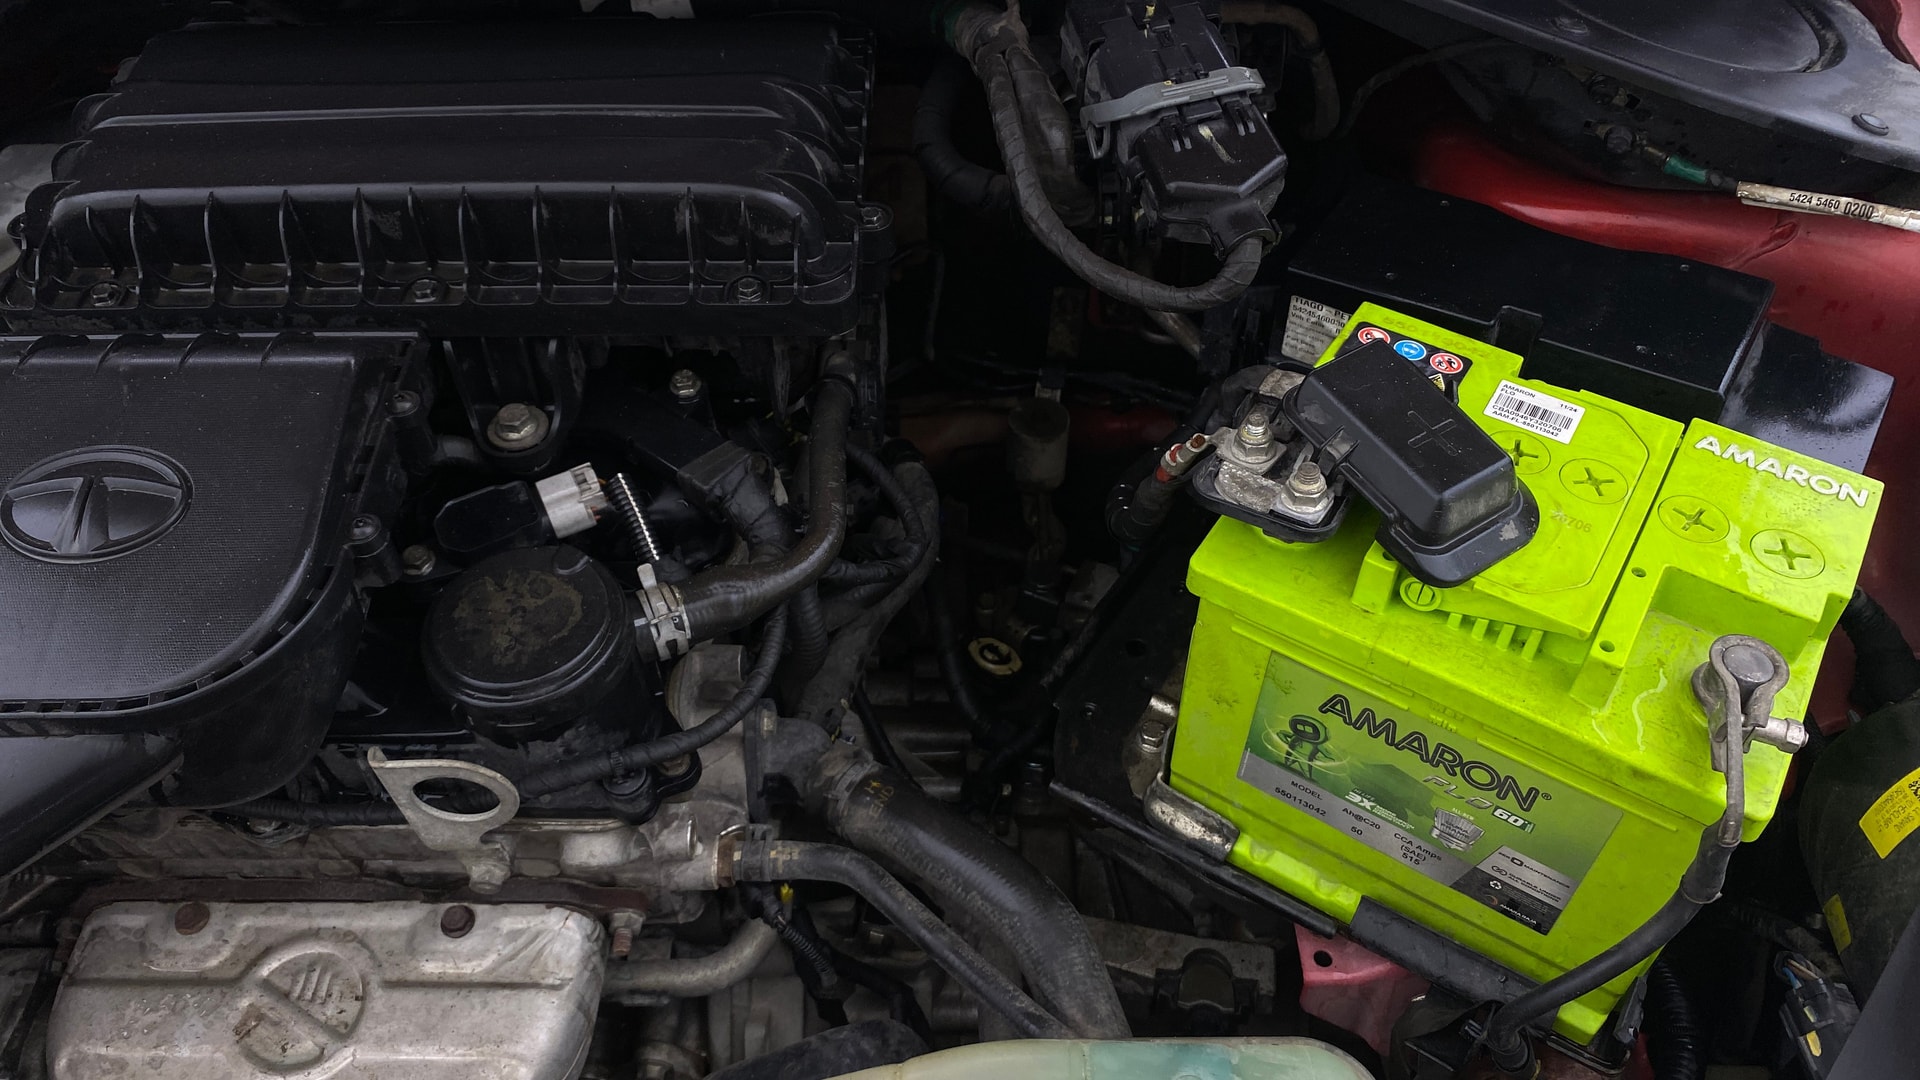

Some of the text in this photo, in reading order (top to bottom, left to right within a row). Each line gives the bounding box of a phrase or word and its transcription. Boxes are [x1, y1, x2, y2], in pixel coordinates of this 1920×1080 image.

[1788, 192, 1876, 220] 5424 5460 0200
[1500, 387, 1516, 397] FLO
[1502, 383, 1578, 413] AMARON 11/24
[1694, 435, 1870, 508] AMARON
[1317, 693, 1540, 813] AMARON
[1274, 786, 1327, 817] 550113042
[1290, 780, 1323, 801] MODEL
[1345, 791, 1377, 811] 3X
[1422, 775, 1495, 810] FLO
[1341, 807, 1381, 830] Ah@C20
[1350, 826, 1363, 836] 50
[1393, 832, 1442, 861] CCA Amps
[1400, 844, 1427, 862] (SAE)
[1401, 852, 1421, 866] 515
